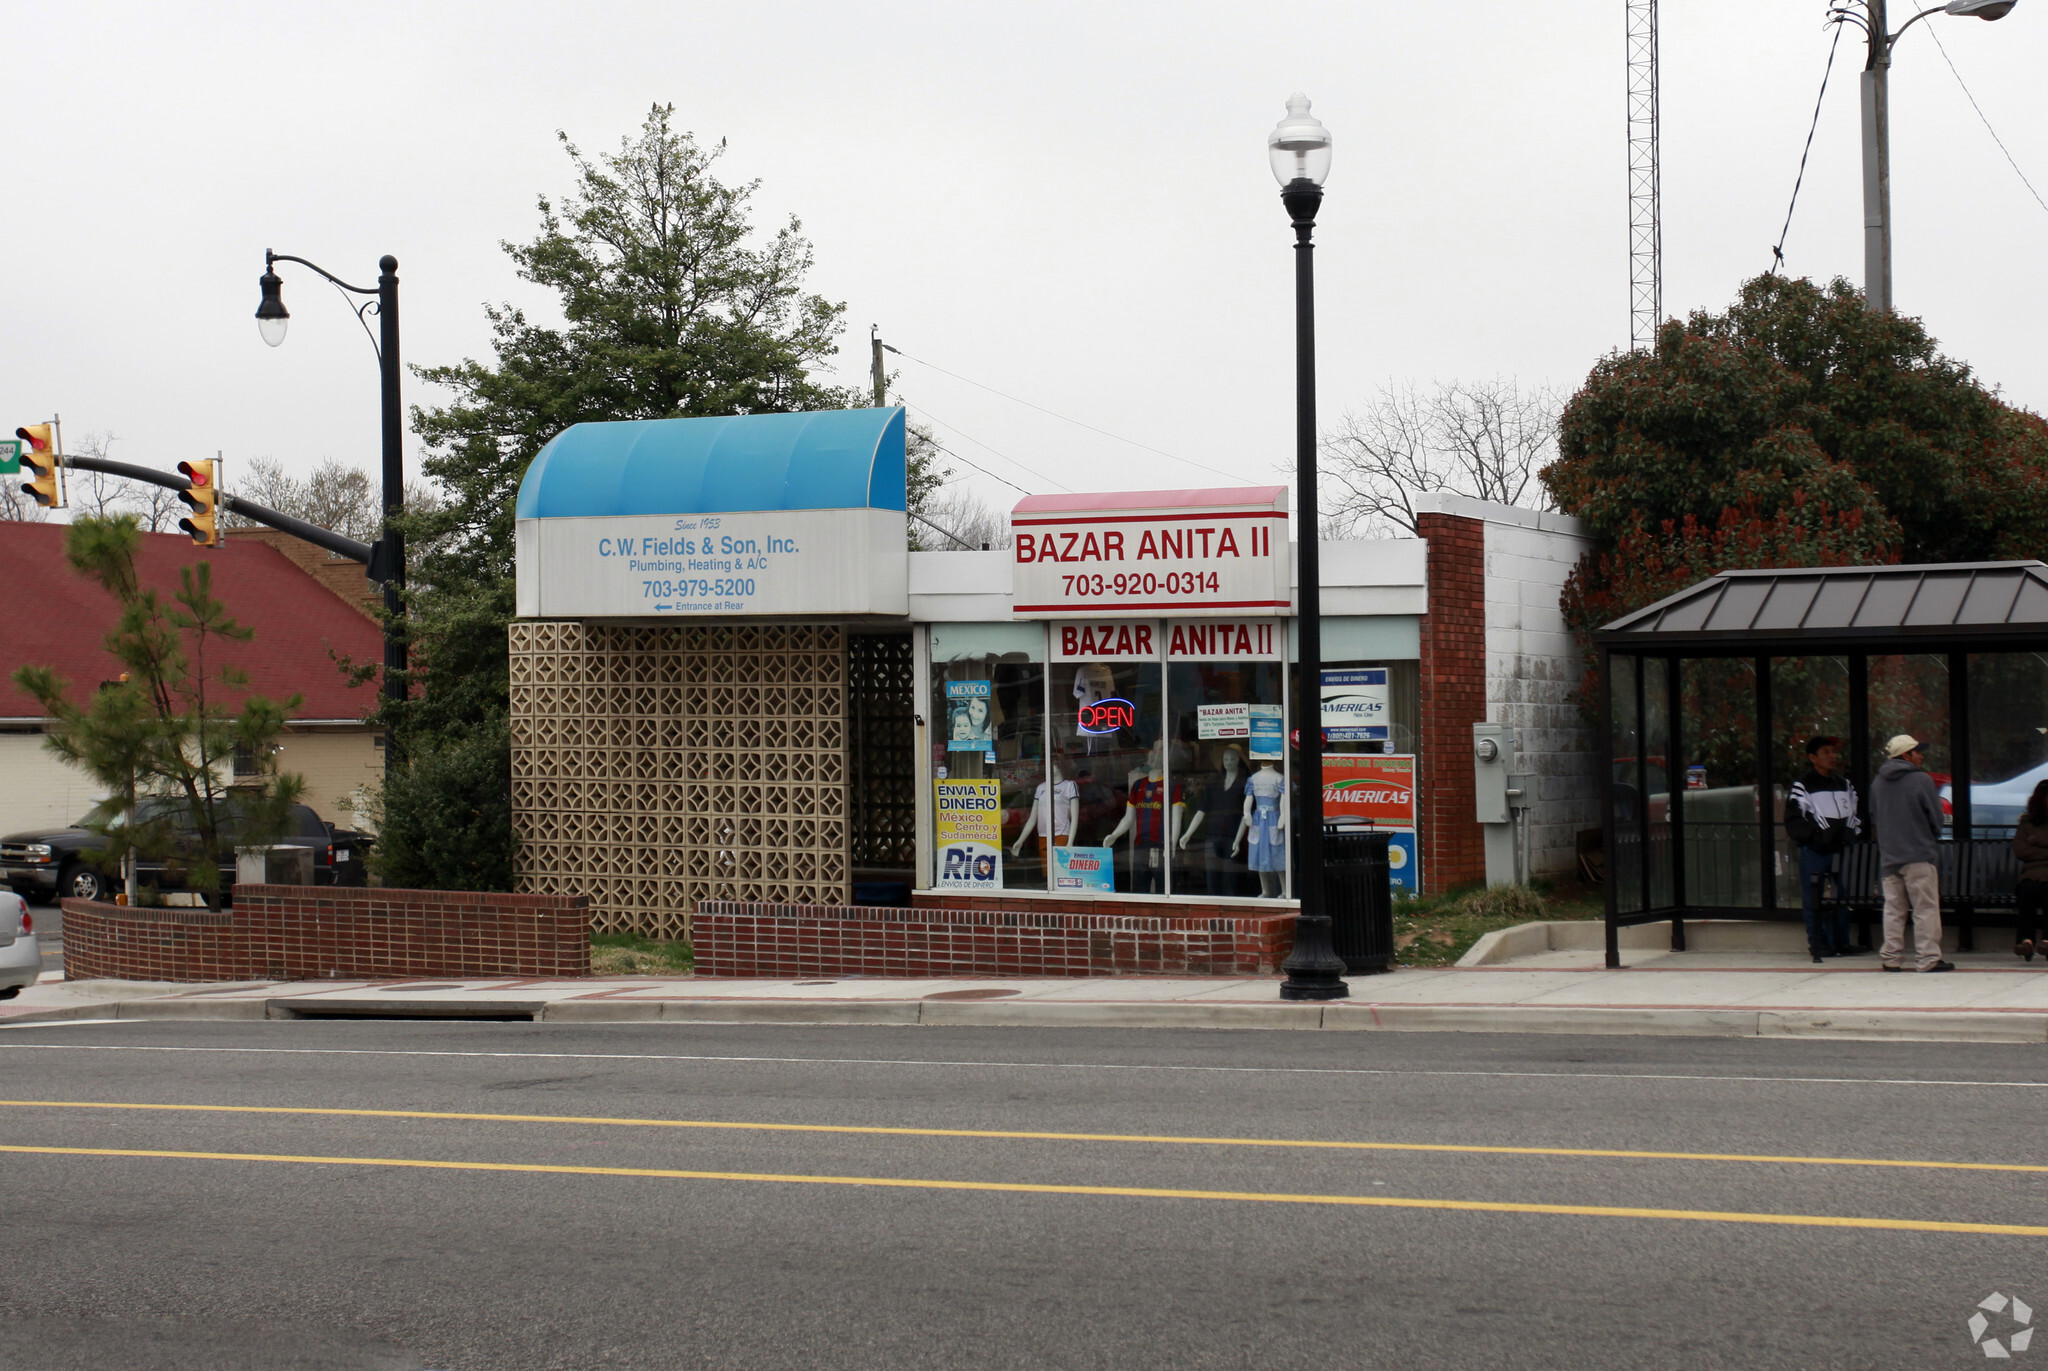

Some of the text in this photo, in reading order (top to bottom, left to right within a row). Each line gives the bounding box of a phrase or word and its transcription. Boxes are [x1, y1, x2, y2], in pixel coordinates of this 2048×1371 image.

[674, 517, 721, 531] Since 1953
[599, 534, 800, 558] C.W. Fields & Son, Inc.
[1016, 526, 1269, 563] BAZAR ANITA II
[629, 556, 768, 574] Plumbing, Heating & A/C
[642, 578, 755, 598] 703-979-5200
[1062, 571, 1220, 596] 703-920-0314
[675, 600, 744, 611] Entrance at Rear
[1061, 624, 1274, 656] BAZAR ANITA II
[1320, 703, 1385, 712] AMERICAS
[1078, 706, 1134, 728] OPEN
[1322, 758, 1413, 768] NVÍOS DE DINERO
[938, 786, 997, 796] ENVIA TU
[939, 798, 997, 810] DINERO
[940, 812, 983, 822] México
[955, 823, 998, 833] Centro y
[940, 831, 998, 840] Sudamérica
[943, 847, 996, 881] Ria
[1069, 859, 1100, 871] DINERO
